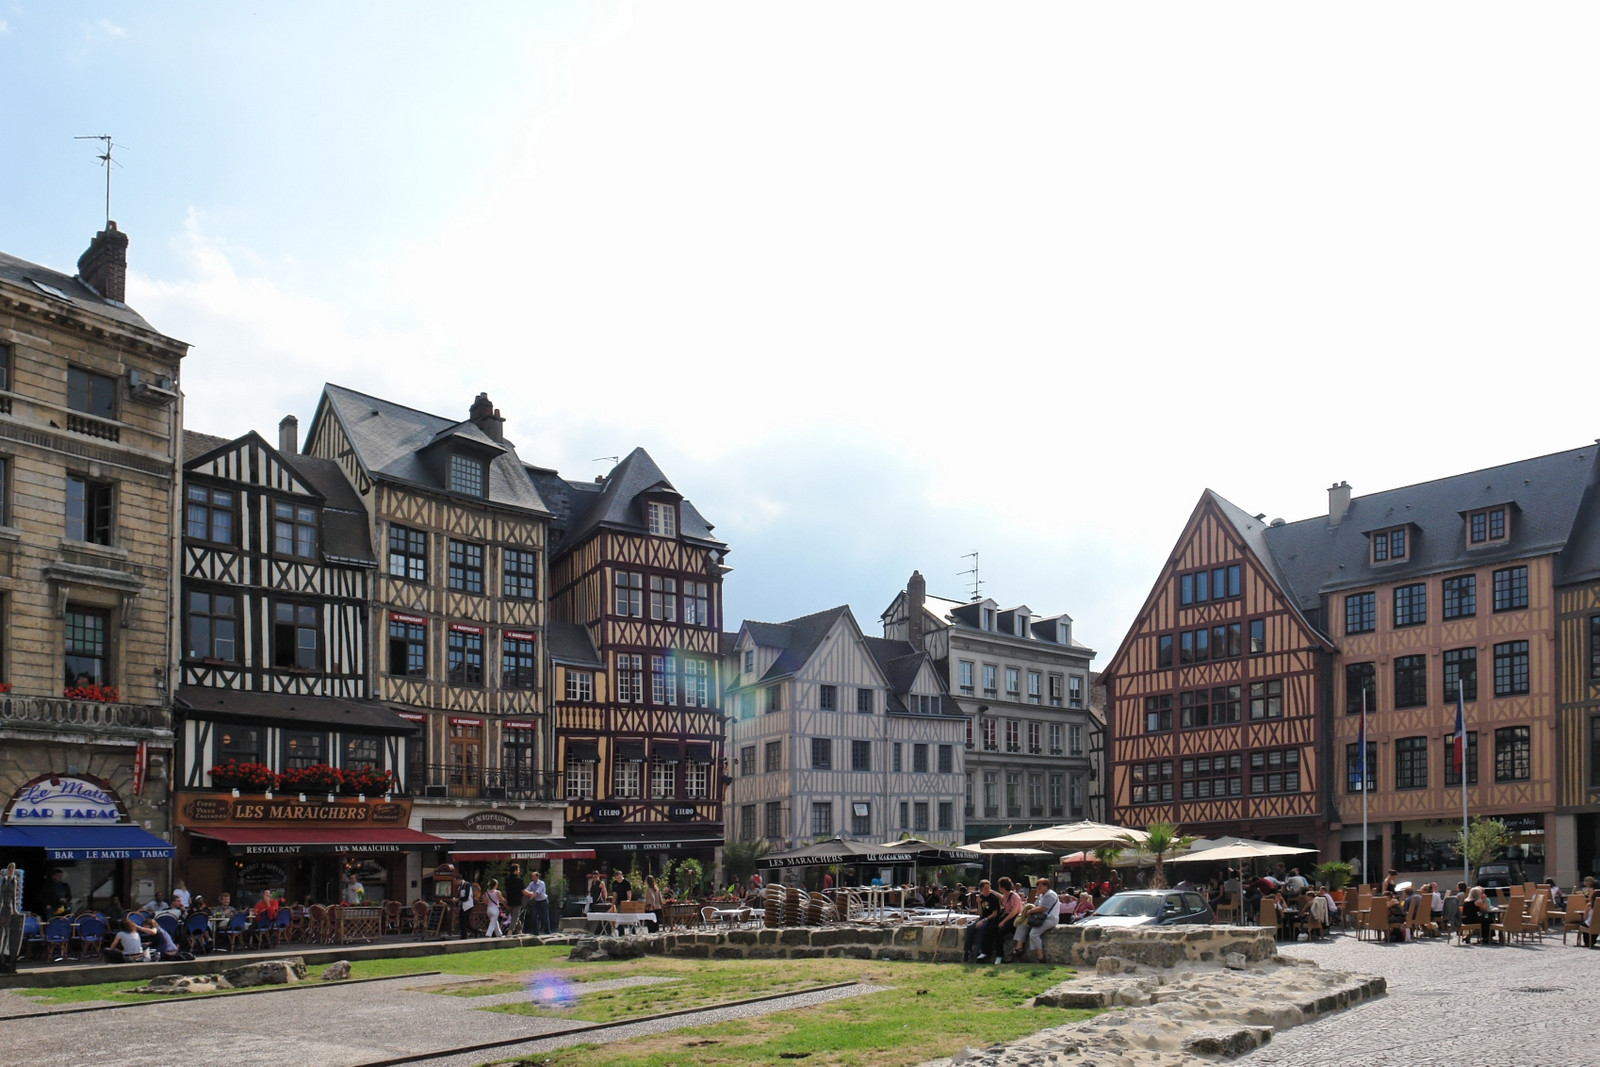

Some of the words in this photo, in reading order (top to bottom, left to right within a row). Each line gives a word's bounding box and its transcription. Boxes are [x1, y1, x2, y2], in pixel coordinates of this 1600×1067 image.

[16, 808, 53, 818] BAR
[63, 808, 120, 819] TABAC
[235, 806, 265, 819] LES
[269, 806, 367, 819] MARAICHERS
[141, 850, 169, 858] TABAC
[246, 846, 301, 854] RESTAURANT
[769, 859, 784, 867] LES
